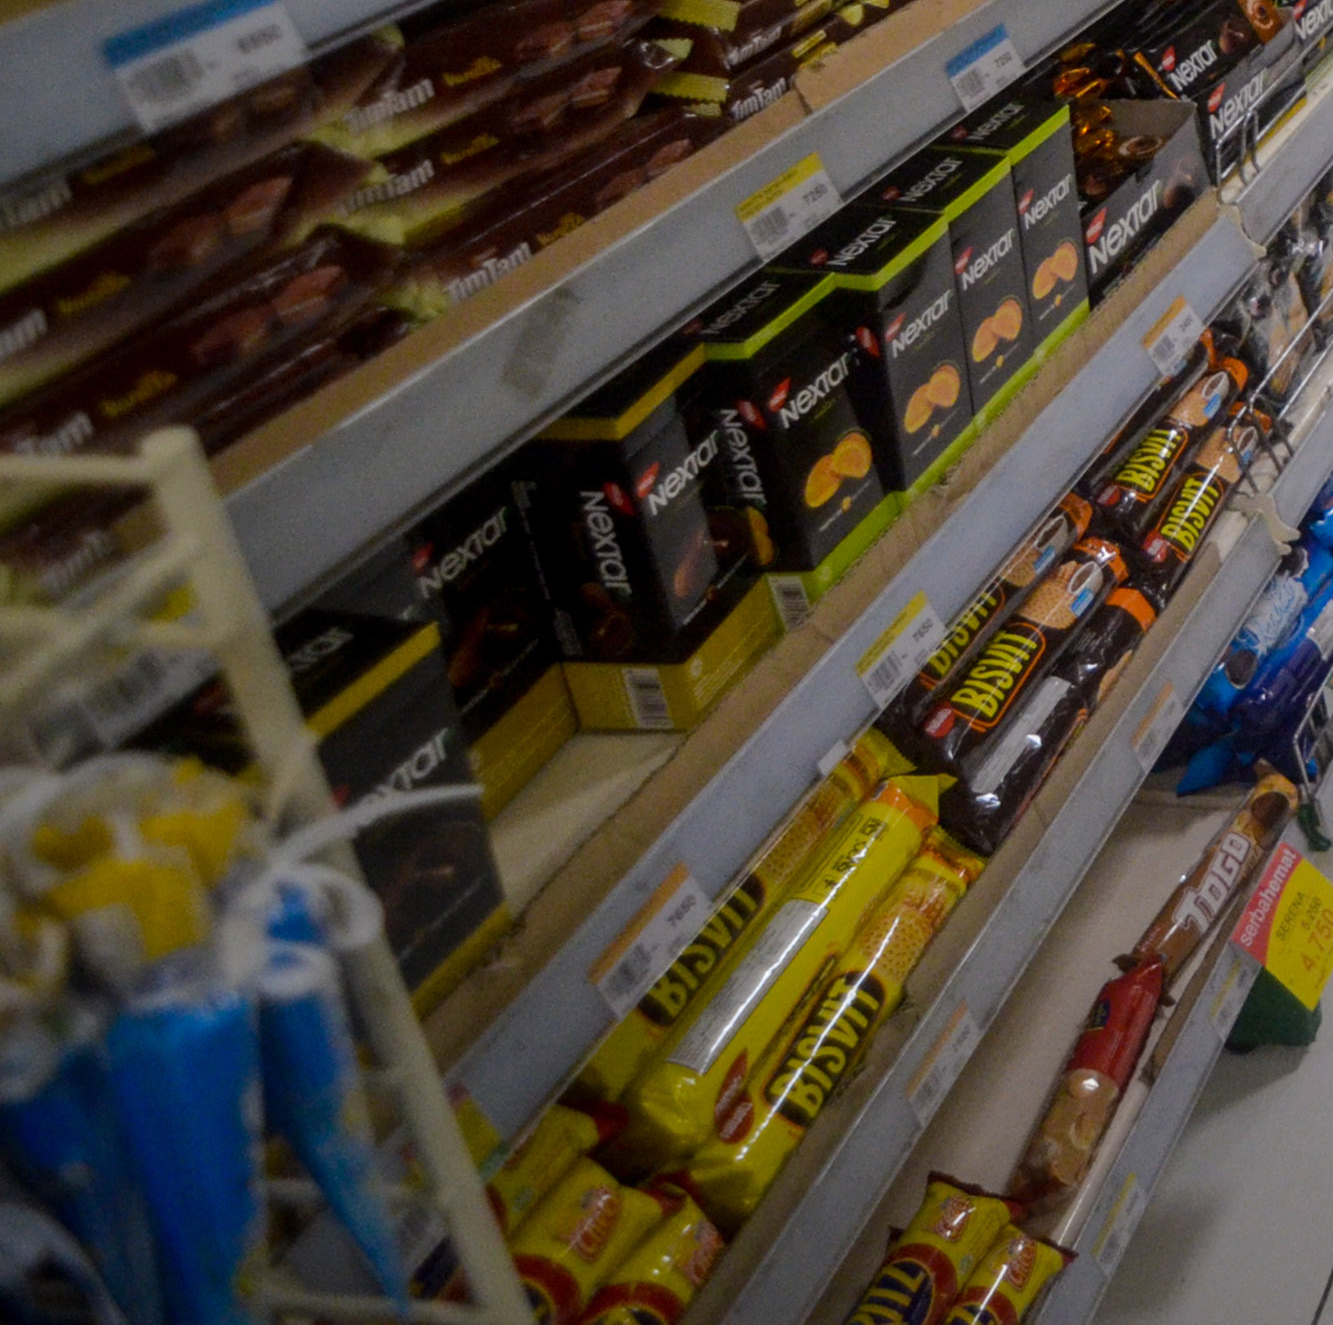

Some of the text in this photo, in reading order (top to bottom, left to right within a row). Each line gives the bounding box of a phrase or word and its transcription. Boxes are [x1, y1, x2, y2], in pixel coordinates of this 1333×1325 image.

[1168, 39, 1218, 93] Nextar
[1021, 175, 1072, 230] Nextar
[1086, 180, 1162, 276] Nextar
[960, 228, 1017, 291] Nextar
[891, 289, 952, 357] Nextar
[778, 352, 852, 429] Nextar
[649, 432, 721, 515] Nextar
[1112, 426, 1184, 495] BISVIT
[420, 504, 509, 599] Nextar
[1159, 475, 1223, 554] BISVIT
[951, 630, 1041, 720] BISVIT
[1239, 847, 1298, 948] serbahemat
[660, 877, 767, 1022] BISVIT
[767, 980, 882, 1119] BISVIT
